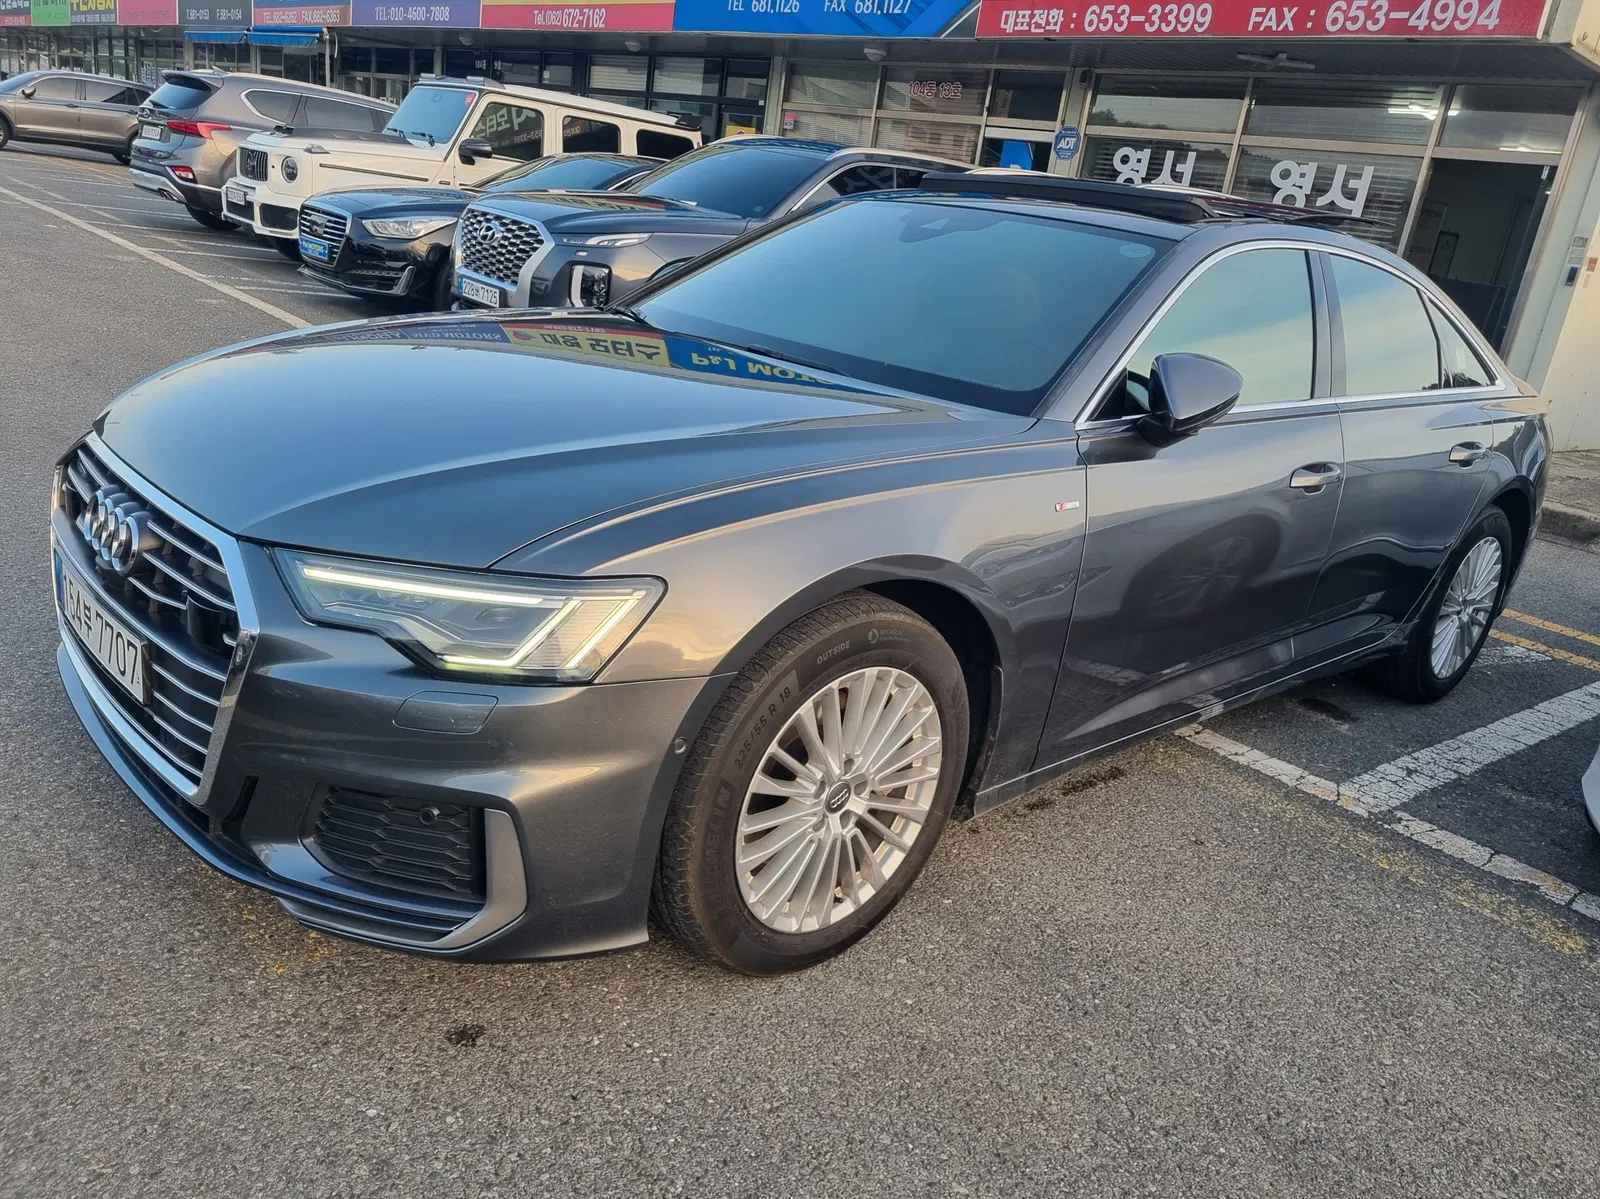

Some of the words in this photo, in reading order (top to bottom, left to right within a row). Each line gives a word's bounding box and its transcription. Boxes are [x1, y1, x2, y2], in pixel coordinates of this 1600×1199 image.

[562, 8, 606, 28] 672-7162
[727, 0, 745, 11] TEL
[824, 0, 847, 12] FAX
[1000, 9, 1064, 33] 대표전화
[1083, 3, 1213, 33] 653-3399
[1248, 7, 1299, 31] FAX
[1325, 0, 1500, 32] 653-4994
[908, 80, 937, 99] 104동
[939, 81, 963, 99] 13호
[1056, 137, 1077, 150] ADT
[1270, 160, 1375, 218] 영서
[816, 640, 851, 665] OUTSIDE
[734, 715, 768, 769] 225/55
[768, 703, 777, 717] R
[778, 686, 791, 702] 18
